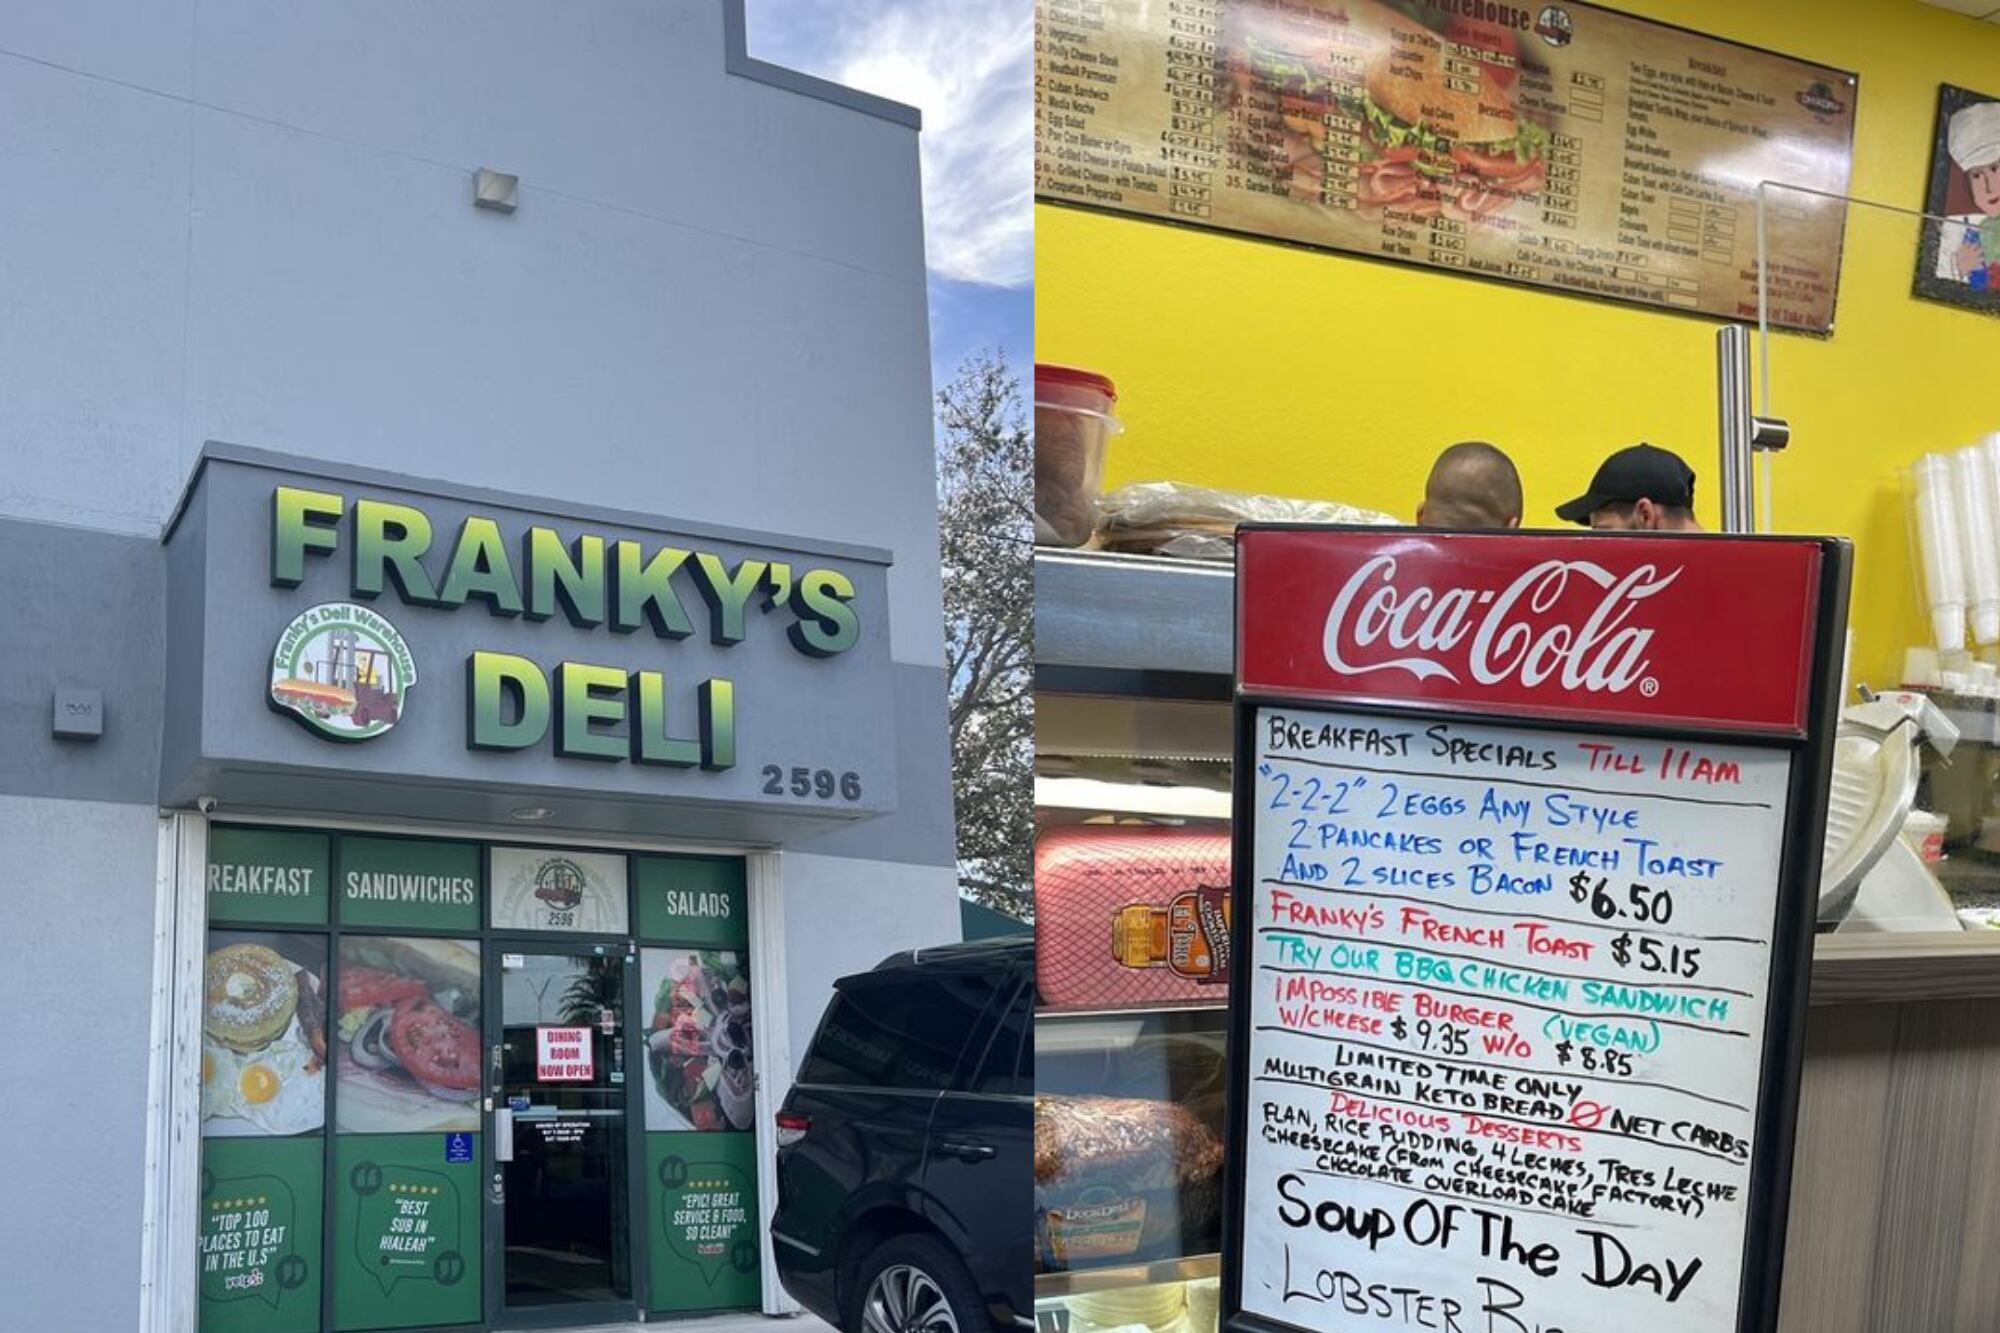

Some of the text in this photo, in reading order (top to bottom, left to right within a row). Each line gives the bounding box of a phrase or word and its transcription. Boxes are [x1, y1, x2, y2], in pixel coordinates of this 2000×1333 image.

[1050, 79, 1109, 101] Cuban Sandwich
[271, 486, 860, 658] FRANKY'S
[276, 607, 413, 682] Franky's Deli Warehouse
[1322, 554, 1685, 694] Coca-Cola
[467, 650, 737, 772] DELI
[1268, 715, 1741, 784] BREAKFAST SPECIALS TILL 11AM
[762, 764, 862, 800] 2596
[1479, 787, 1530, 828] ANY
[1545, 793, 1639, 835] STYLE
[1288, 818, 1724, 878] 2 PANCAKES OR FRENCH TOAST
[347, 872, 473, 905] SANDWICHES
[667, 891, 729, 918] SALADS
[1280, 853, 1673, 925] AND 2 SLICES BACON $6.50
[1271, 889, 1384, 935] FRANKY'S
[1400, 907, 1504, 949] FRENCH
[1513, 923, 1595, 961] TOAST
[1611, 932, 1701, 979] $5.15
[1266, 934, 1730, 1021] TRY OUR BBQ CHICKEN SANDWICH
[546, 1031, 582, 1043] DINING
[1275, 976, 1662, 1054] IMPOSSIBLE BURGER (VEGAN)
[1279, 1003, 1383, 1035] W/CHEESE
[1482, 1032, 1532, 1059] W/O
[540, 1064, 592, 1077] NOW OPEN
[550, 1047, 579, 1060] ROOM
[1335, 1044, 1583, 1106] LIMITED TIME ONLY
[1263, 1058, 1402, 1096] MULTIGRAIN
[1415, 1081, 1477, 1107] KETO
[1483, 1092, 1564, 1121] BREAD
[1610, 1108, 1667, 1137] NET
[1670, 1120, 1750, 1160] CARBS
[1330, 1089, 1583, 1152] DELICIOUS DESSERTS
[1261, 1124, 1704, 1219] CHEESECAKE (FROM CHEESECAKE FACTORY)
[1262, 1101, 1318, 1134] FLAN,
[1324, 1112, 1371, 1138] RICE
[1598, 1159, 1656, 1187] TRES
[1663, 1165, 1738, 1201] LECHE
[712, 1192, 739, 1207] GREAT
[1316, 1154, 1596, 1218] CHOCOLATE OVERLOAD CAKE
[244, 1209, 269, 1228] 100
[245, 1230, 259, 1247] TO
[262, 1226, 286, 1245] EAT
[415, 1219, 429, 1233] IN
[674, 1210, 710, 1225] SERVICE
[686, 1226, 698, 1240] SO
[205, 1254, 218, 1271] IN
[223, 1251, 245, 1269] THE
[1403, 1198, 1467, 1248] OF
[1471, 1208, 1560, 1277] The
[1575, 1229, 1702, 1302] DAY
[1282, 1243, 1462, 1333] LOBSTER
